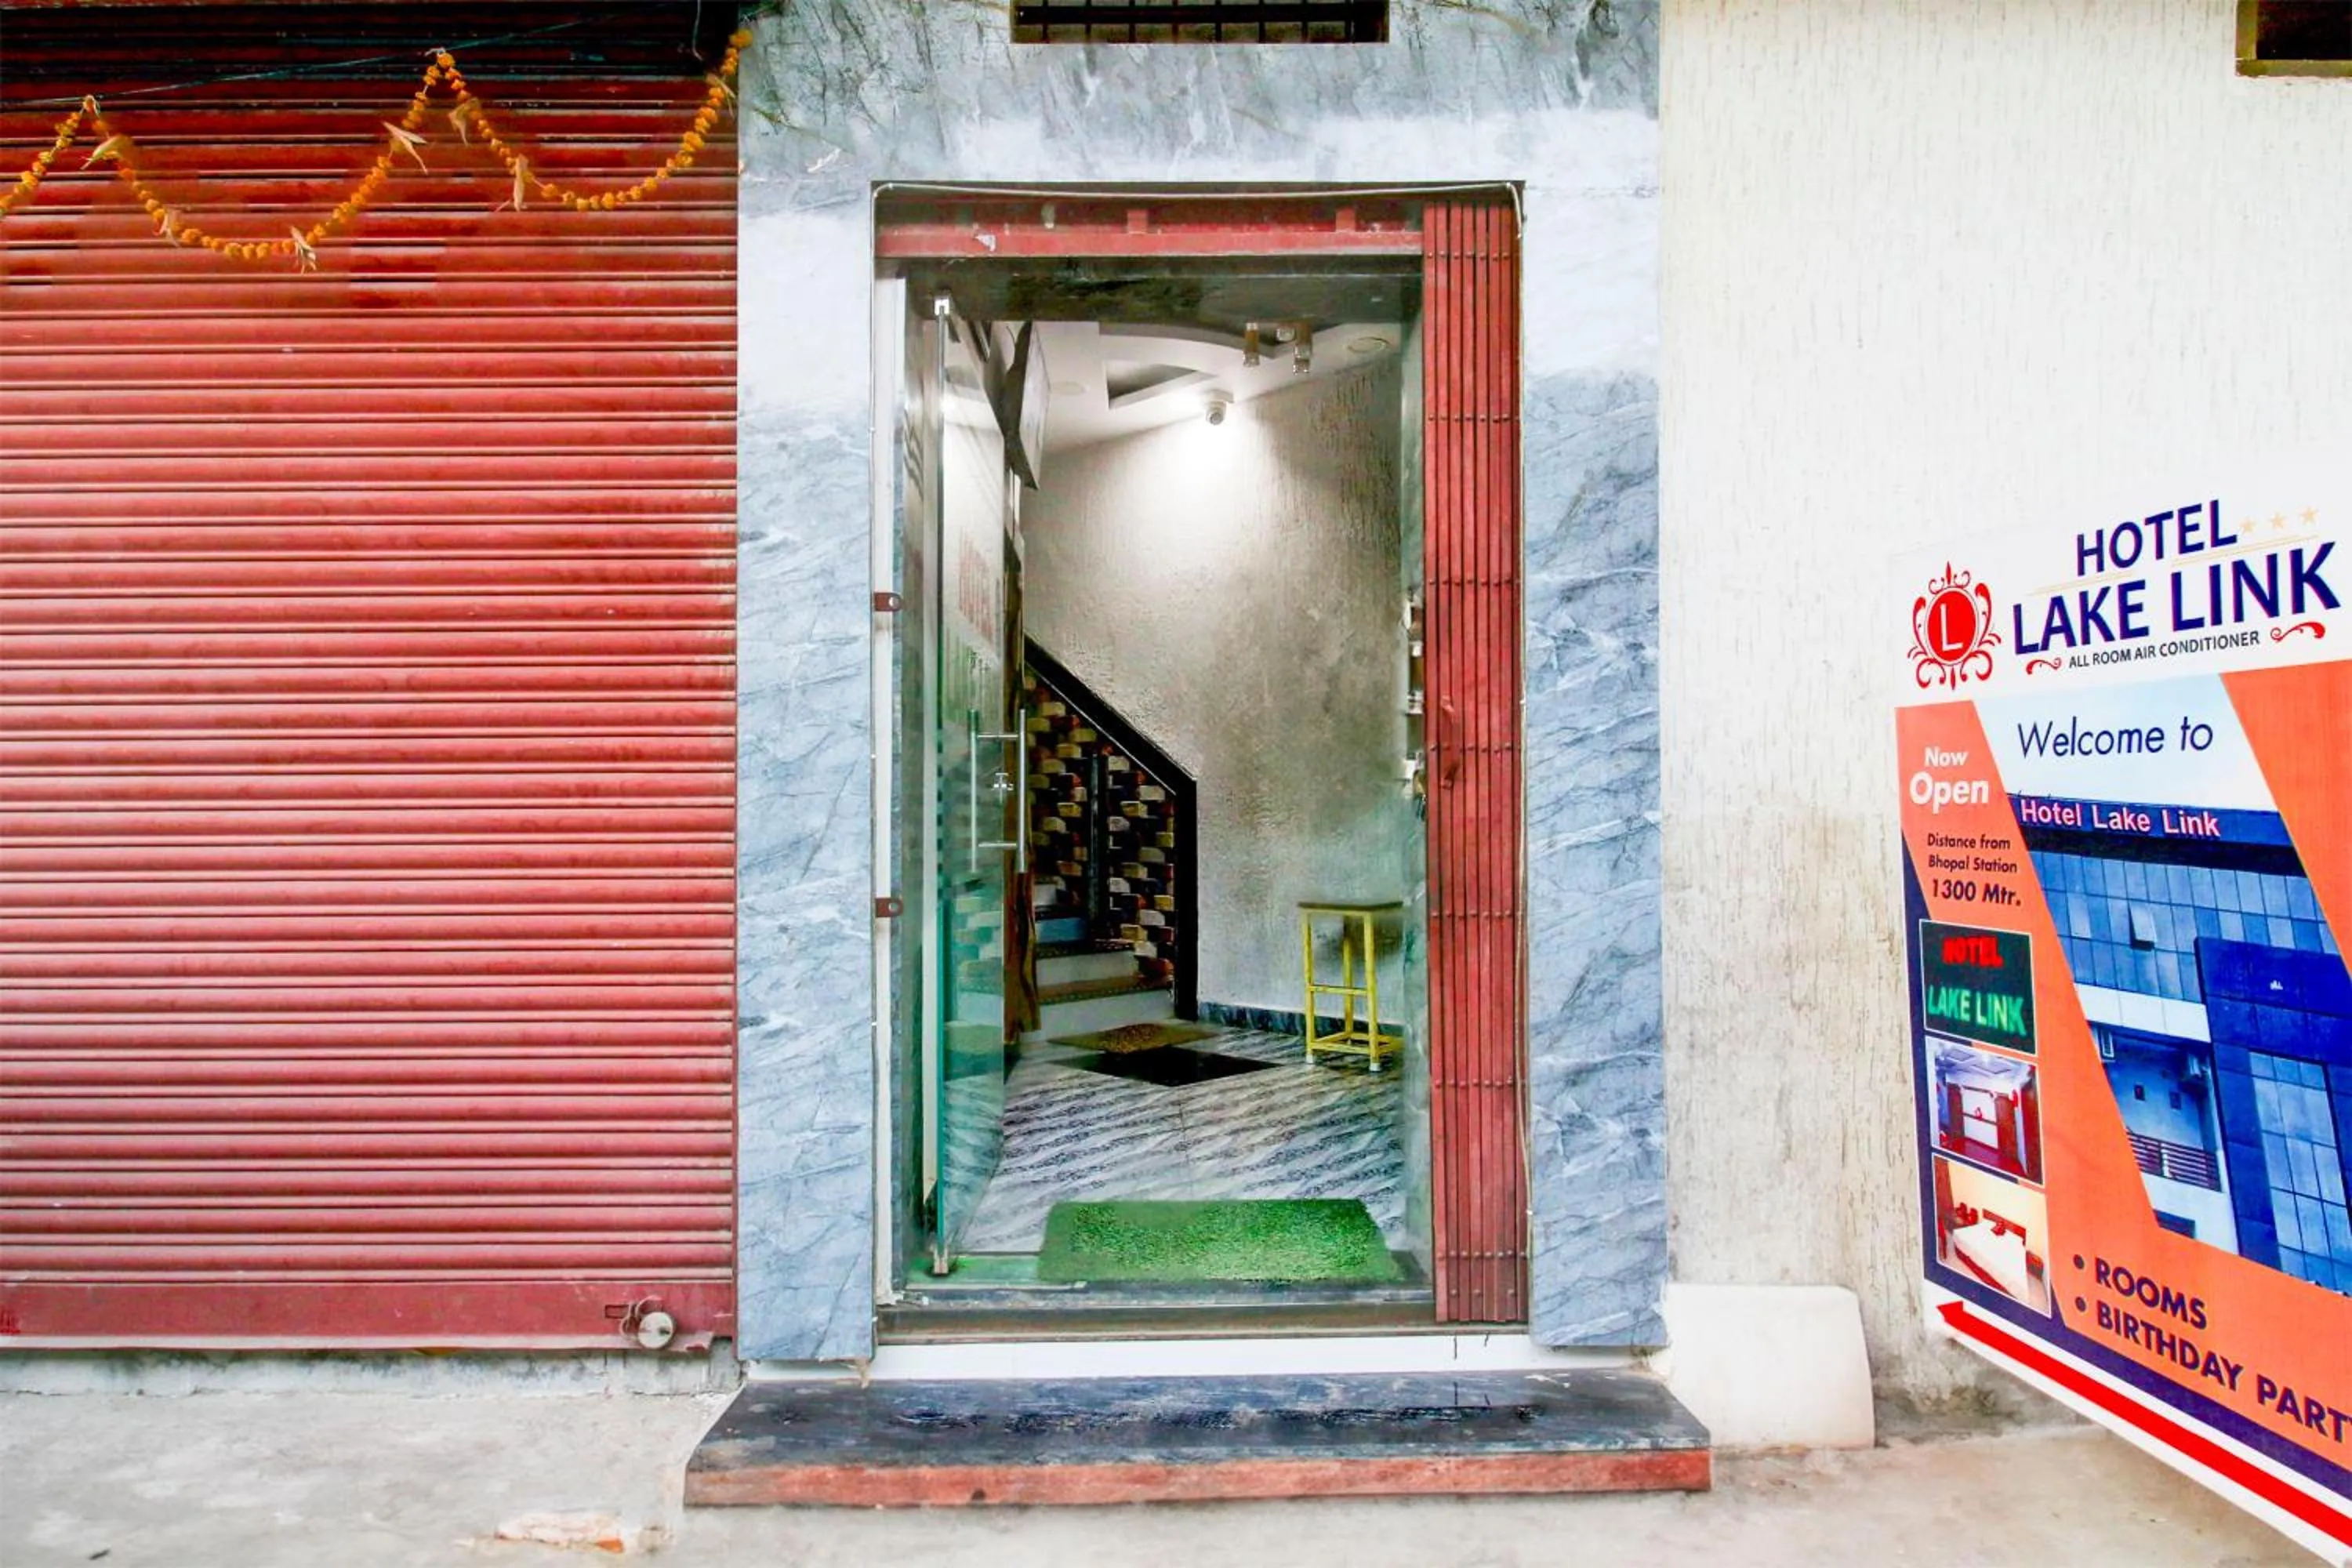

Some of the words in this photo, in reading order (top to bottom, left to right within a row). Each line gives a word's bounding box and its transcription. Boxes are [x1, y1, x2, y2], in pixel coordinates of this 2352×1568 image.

[2076, 499, 2238, 576] HOTEL
[2013, 579, 2150, 655] LAKE
[2170, 541, 2341, 633] LINK
[1941, 601, 1963, 652] L
[2069, 655, 2089, 669] ALL
[2092, 648, 2131, 666] ROOM
[2135, 645, 2156, 660] AIR
[2159, 630, 2260, 657] CONDITIONER
[1925, 746, 1969, 767] Now
[2017, 716, 2165, 758] Welcome
[2180, 715, 2213, 751] to
[1910, 771, 1989, 815] Open
[2020, 799, 2082, 827] Hotel
[2092, 805, 2151, 833] Lake
[2162, 809, 2220, 837] Link
[1927, 833, 1976, 848] Distance
[1980, 833, 2011, 849] from
[1928, 854, 1969, 873] Bhopal
[1973, 857, 2017, 873] Station
[1932, 879, 1976, 902] 1300
[1982, 883, 2021, 906] Mtr.
[1942, 935, 2003, 968] HOTEL
[1928, 985, 1970, 1022] LAKE
[1976, 991, 2027, 1036] LINK
[2095, 1257, 2207, 1330] ROOMS
[2097, 1300, 2243, 1392] BIRTHDAY
[2257, 1374, 2352, 1443] PART
